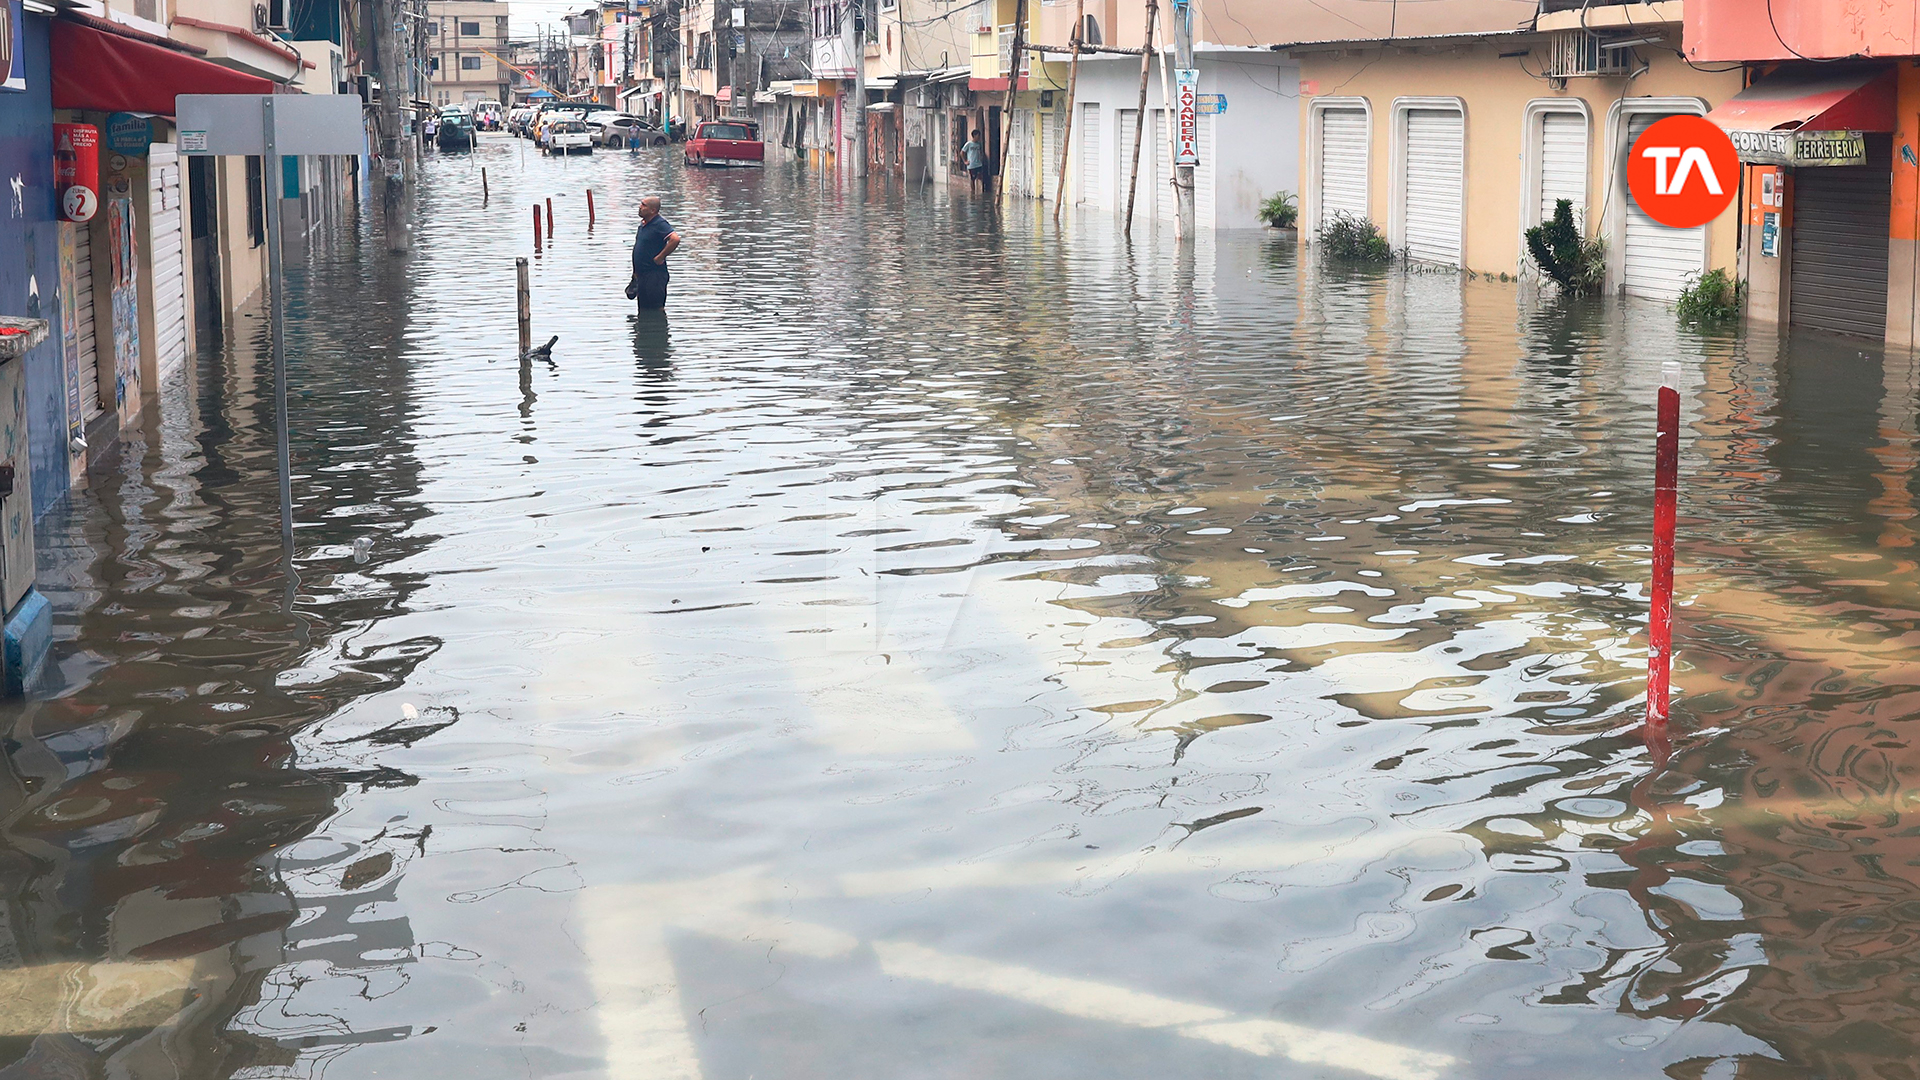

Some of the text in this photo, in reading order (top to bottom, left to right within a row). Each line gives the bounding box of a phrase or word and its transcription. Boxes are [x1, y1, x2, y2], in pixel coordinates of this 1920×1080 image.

[112, 119, 146, 133] familia
[1181, 86, 1194, 156] LAVANDERIA
[1731, 132, 1786, 154] CORVER
[1797, 140, 1860, 159] FERRETERIA
